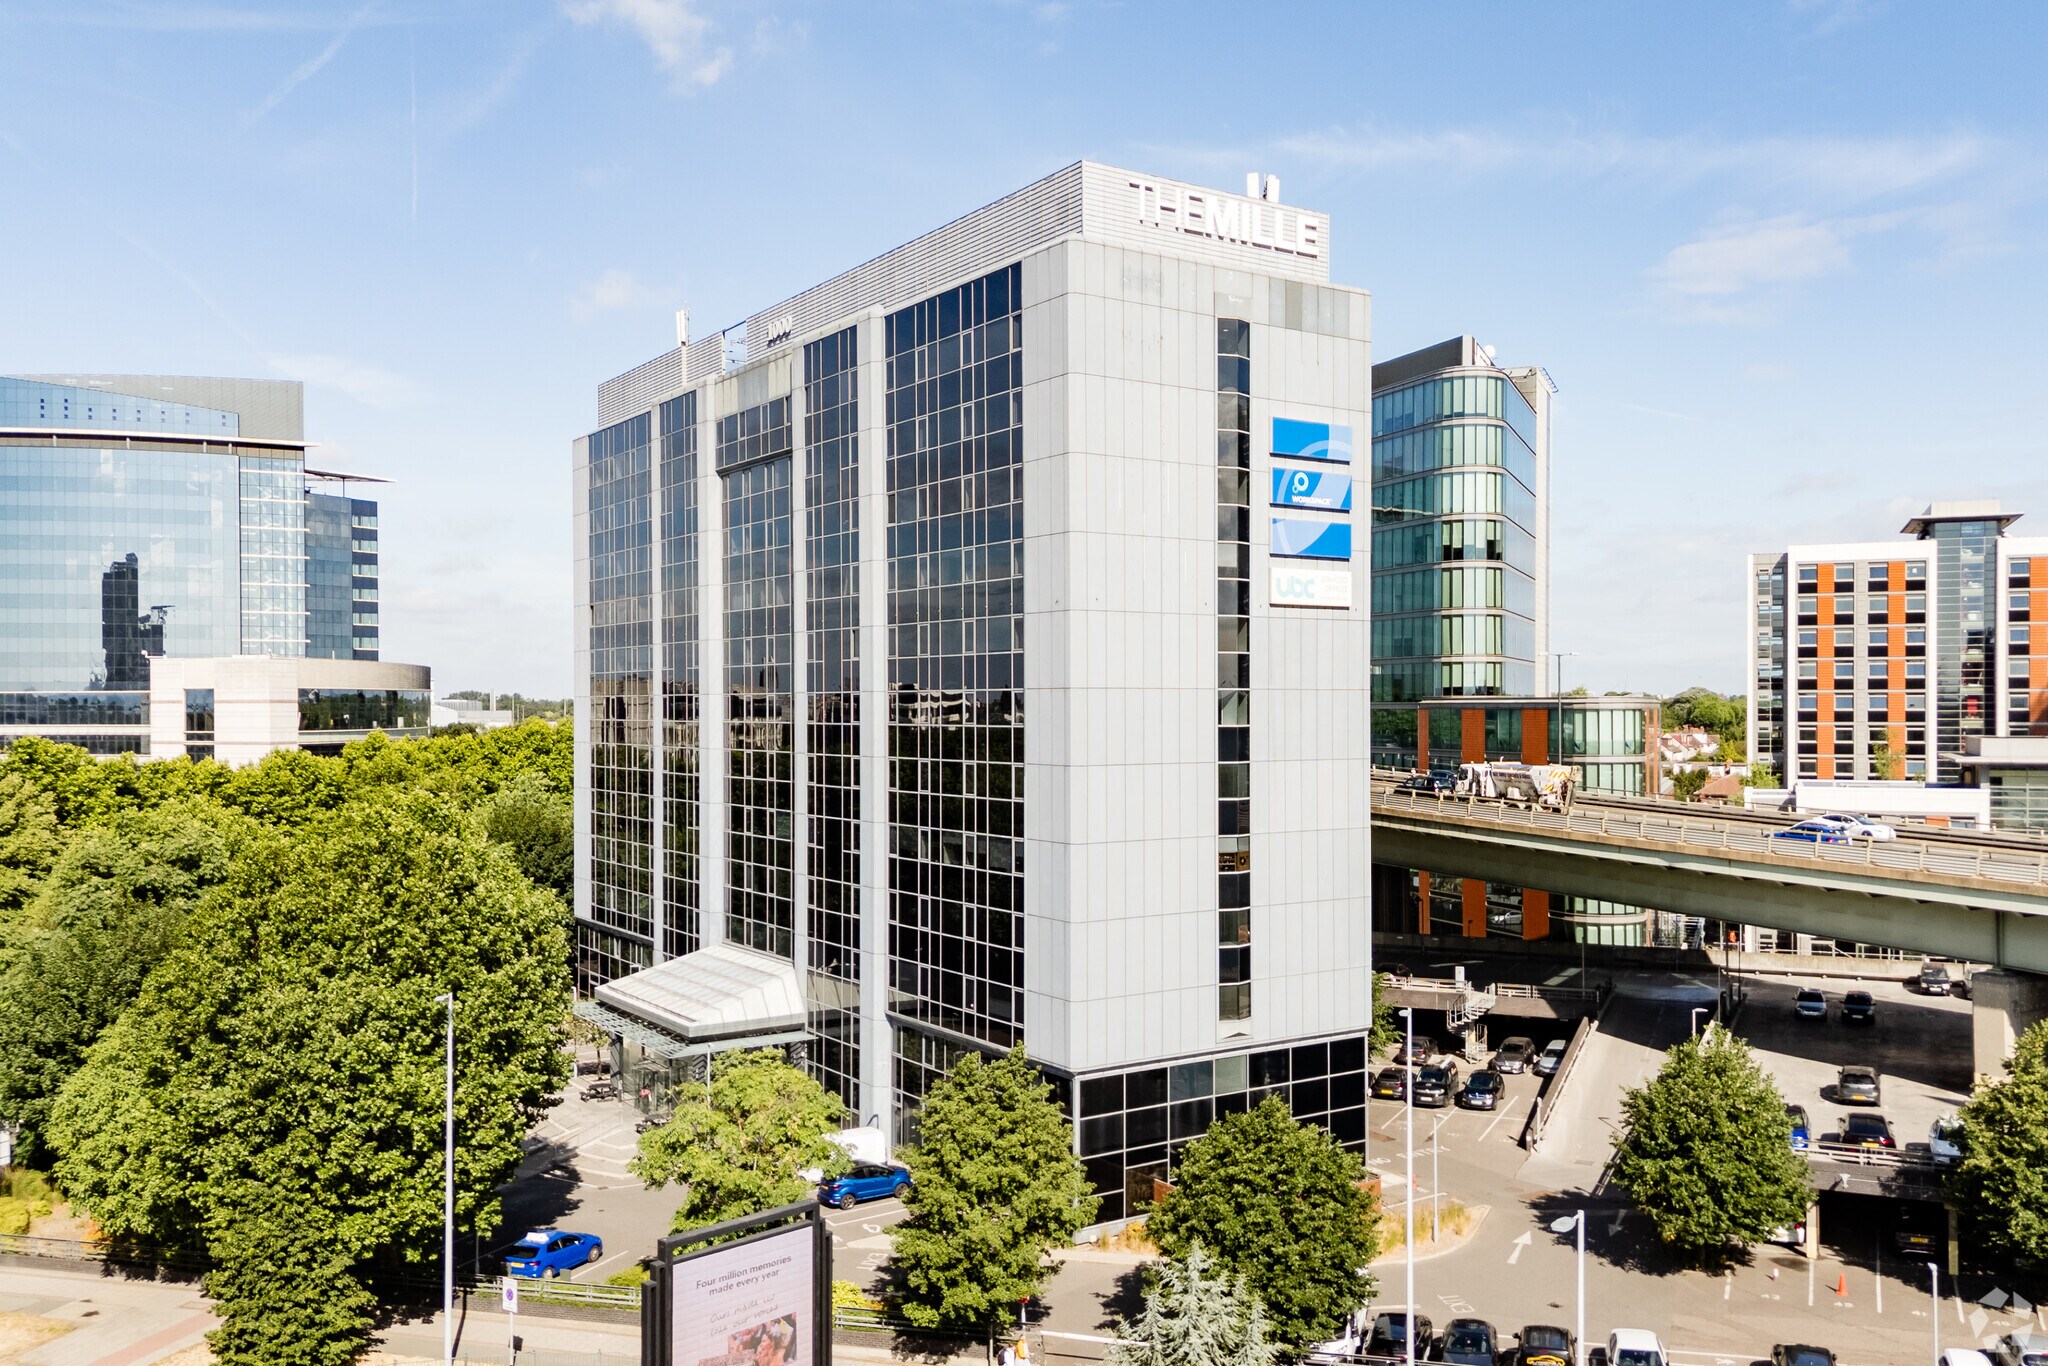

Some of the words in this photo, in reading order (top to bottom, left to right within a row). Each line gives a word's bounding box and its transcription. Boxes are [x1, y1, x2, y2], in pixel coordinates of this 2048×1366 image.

[1291, 495, 1331, 506] WORKSPACE
[696, 1278, 716, 1290] Four
[719, 1270, 748, 1283] million
[750, 1256, 792, 1273] memories
[709, 1283, 734, 1295] made
[736, 1275, 760, 1288] every
[762, 1269, 780, 1282] year
[1437, 1294, 1476, 1312] EXIT
